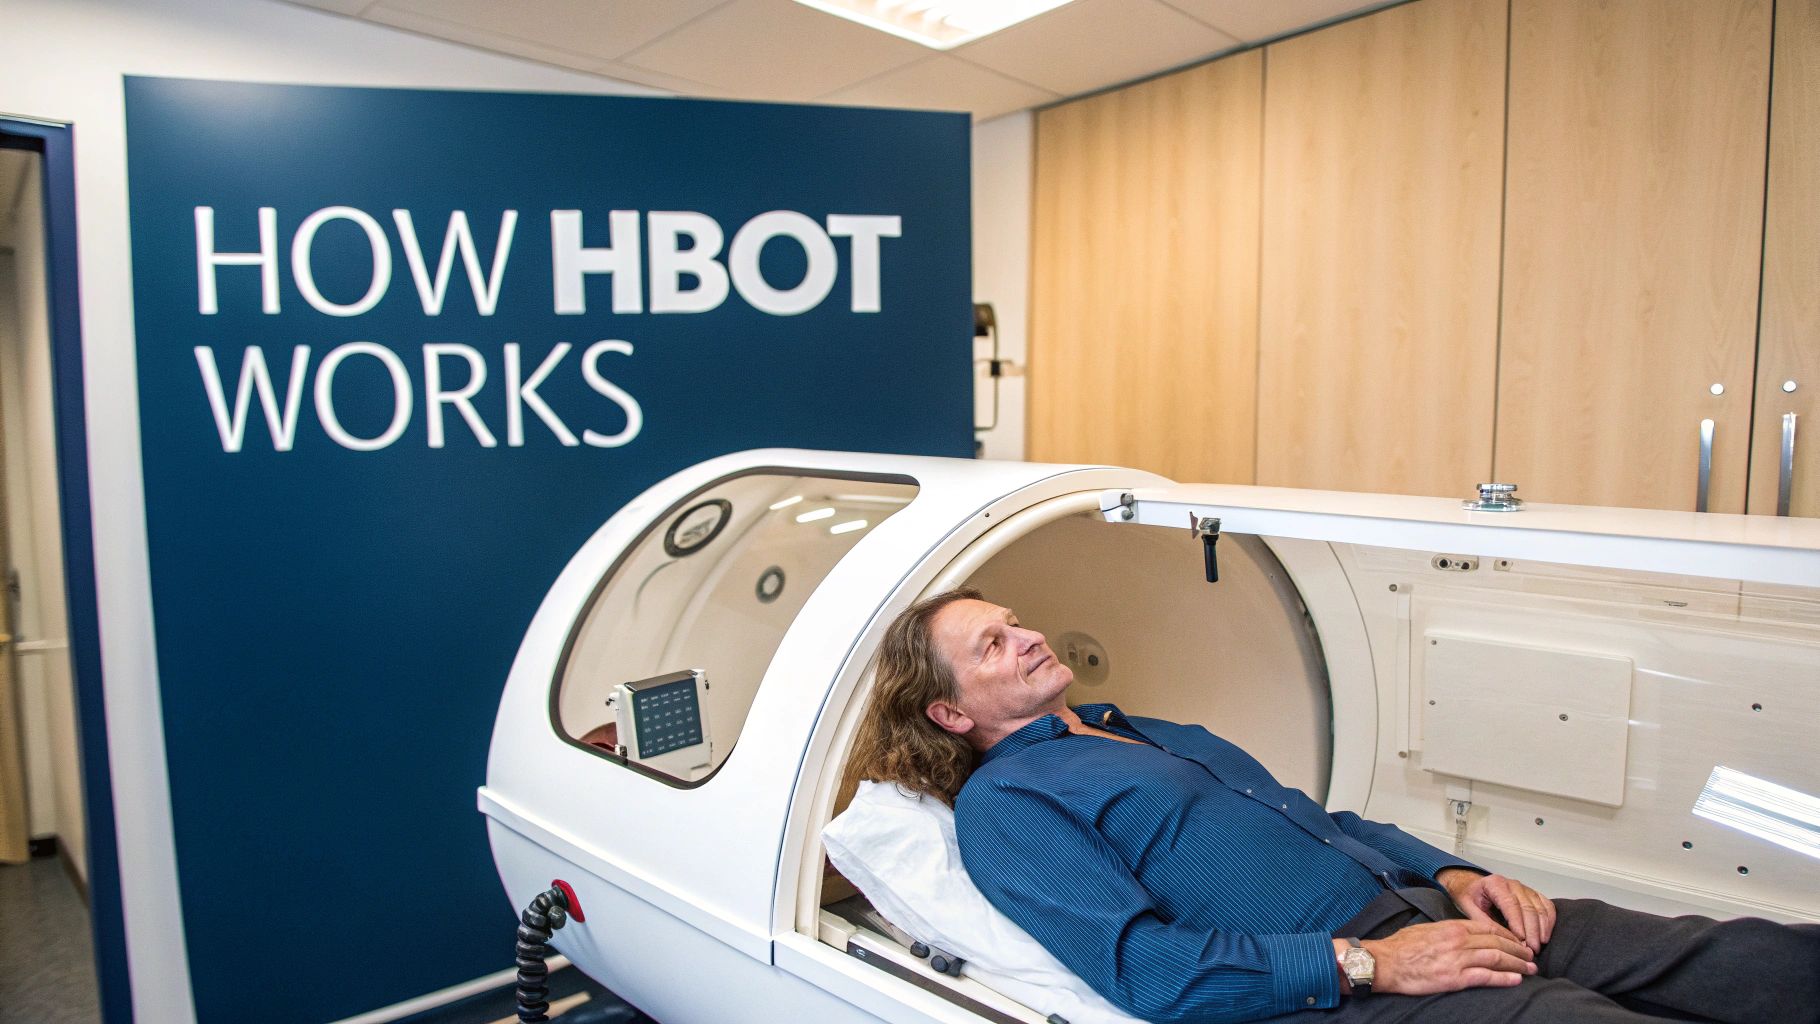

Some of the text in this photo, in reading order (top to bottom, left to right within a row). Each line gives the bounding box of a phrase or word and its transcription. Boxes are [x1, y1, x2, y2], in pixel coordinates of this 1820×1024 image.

[193, 205, 902, 317] HOW HBOT
[193, 339, 643, 453] WORKS
